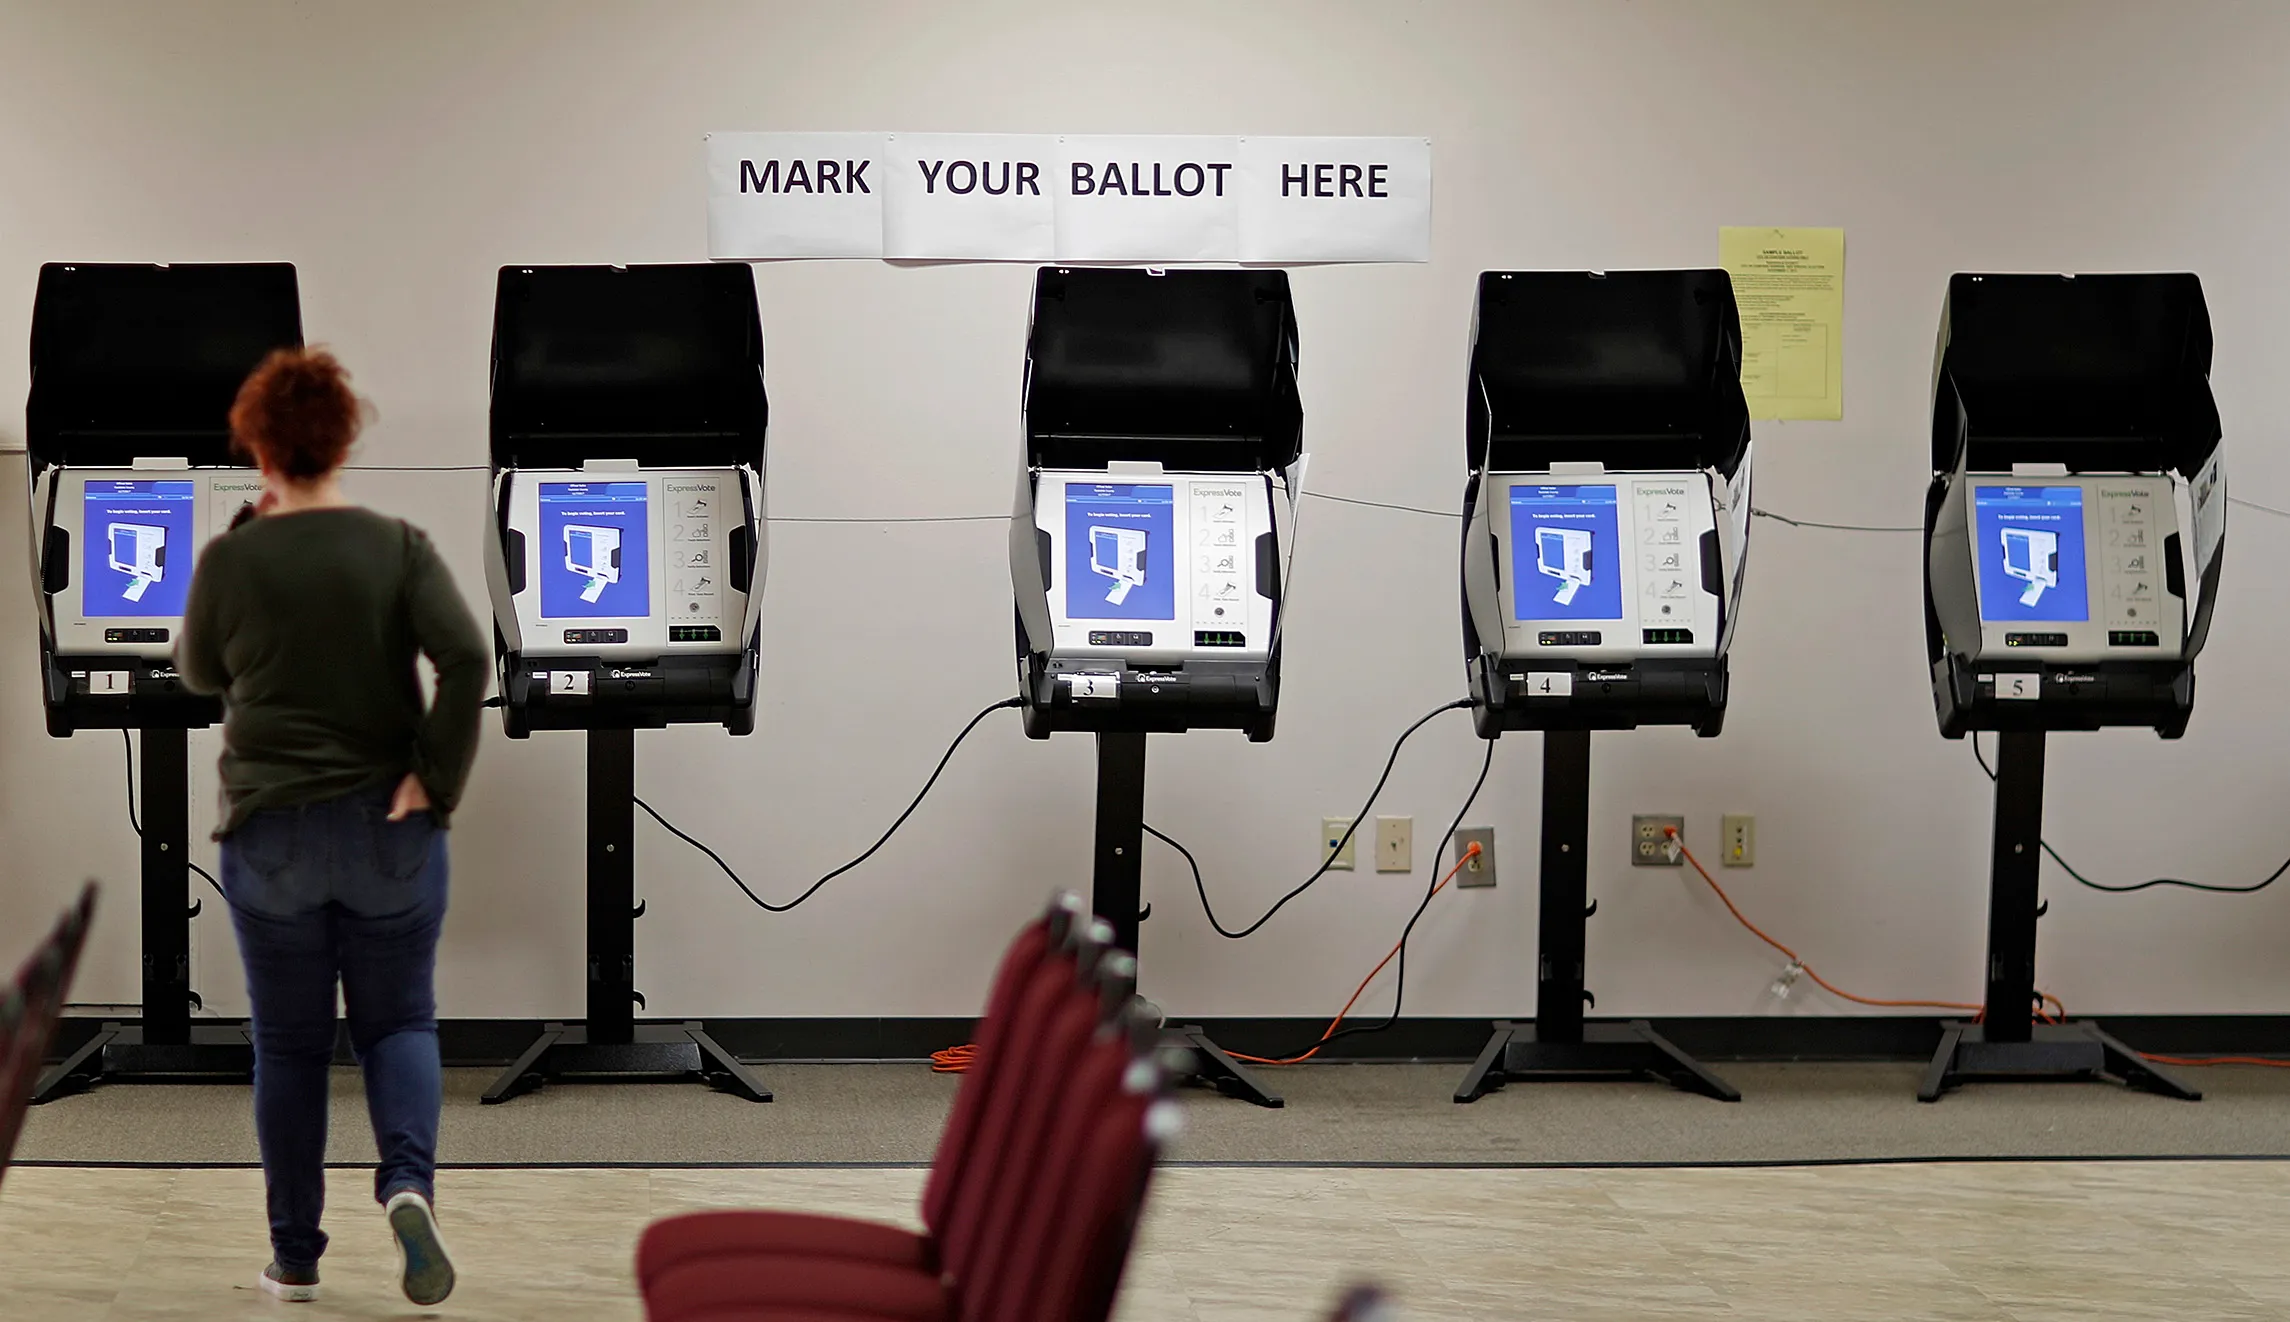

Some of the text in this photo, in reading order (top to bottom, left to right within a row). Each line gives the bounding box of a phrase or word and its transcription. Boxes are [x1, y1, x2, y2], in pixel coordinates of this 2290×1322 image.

[739, 159, 1388, 198] MARK YOUR BALLOT HERE
[667, 484, 716, 493] ExpressVote
[1193, 488, 1242, 498] ExpressVote
[1636, 487, 1685, 497] ExpressVote
[673, 500, 681, 518] 1
[673, 524, 684, 542] 2
[673, 550, 685, 569] 3
[673, 579, 685, 597] 4
[105, 673, 114, 690] 1
[563, 674, 575, 691] 2
[1540, 675, 1551, 693] 4
[1597, 673, 1627, 681] ExpressVote
[1082, 678, 1095, 696] 3
[2012, 680, 2024, 697] 5
